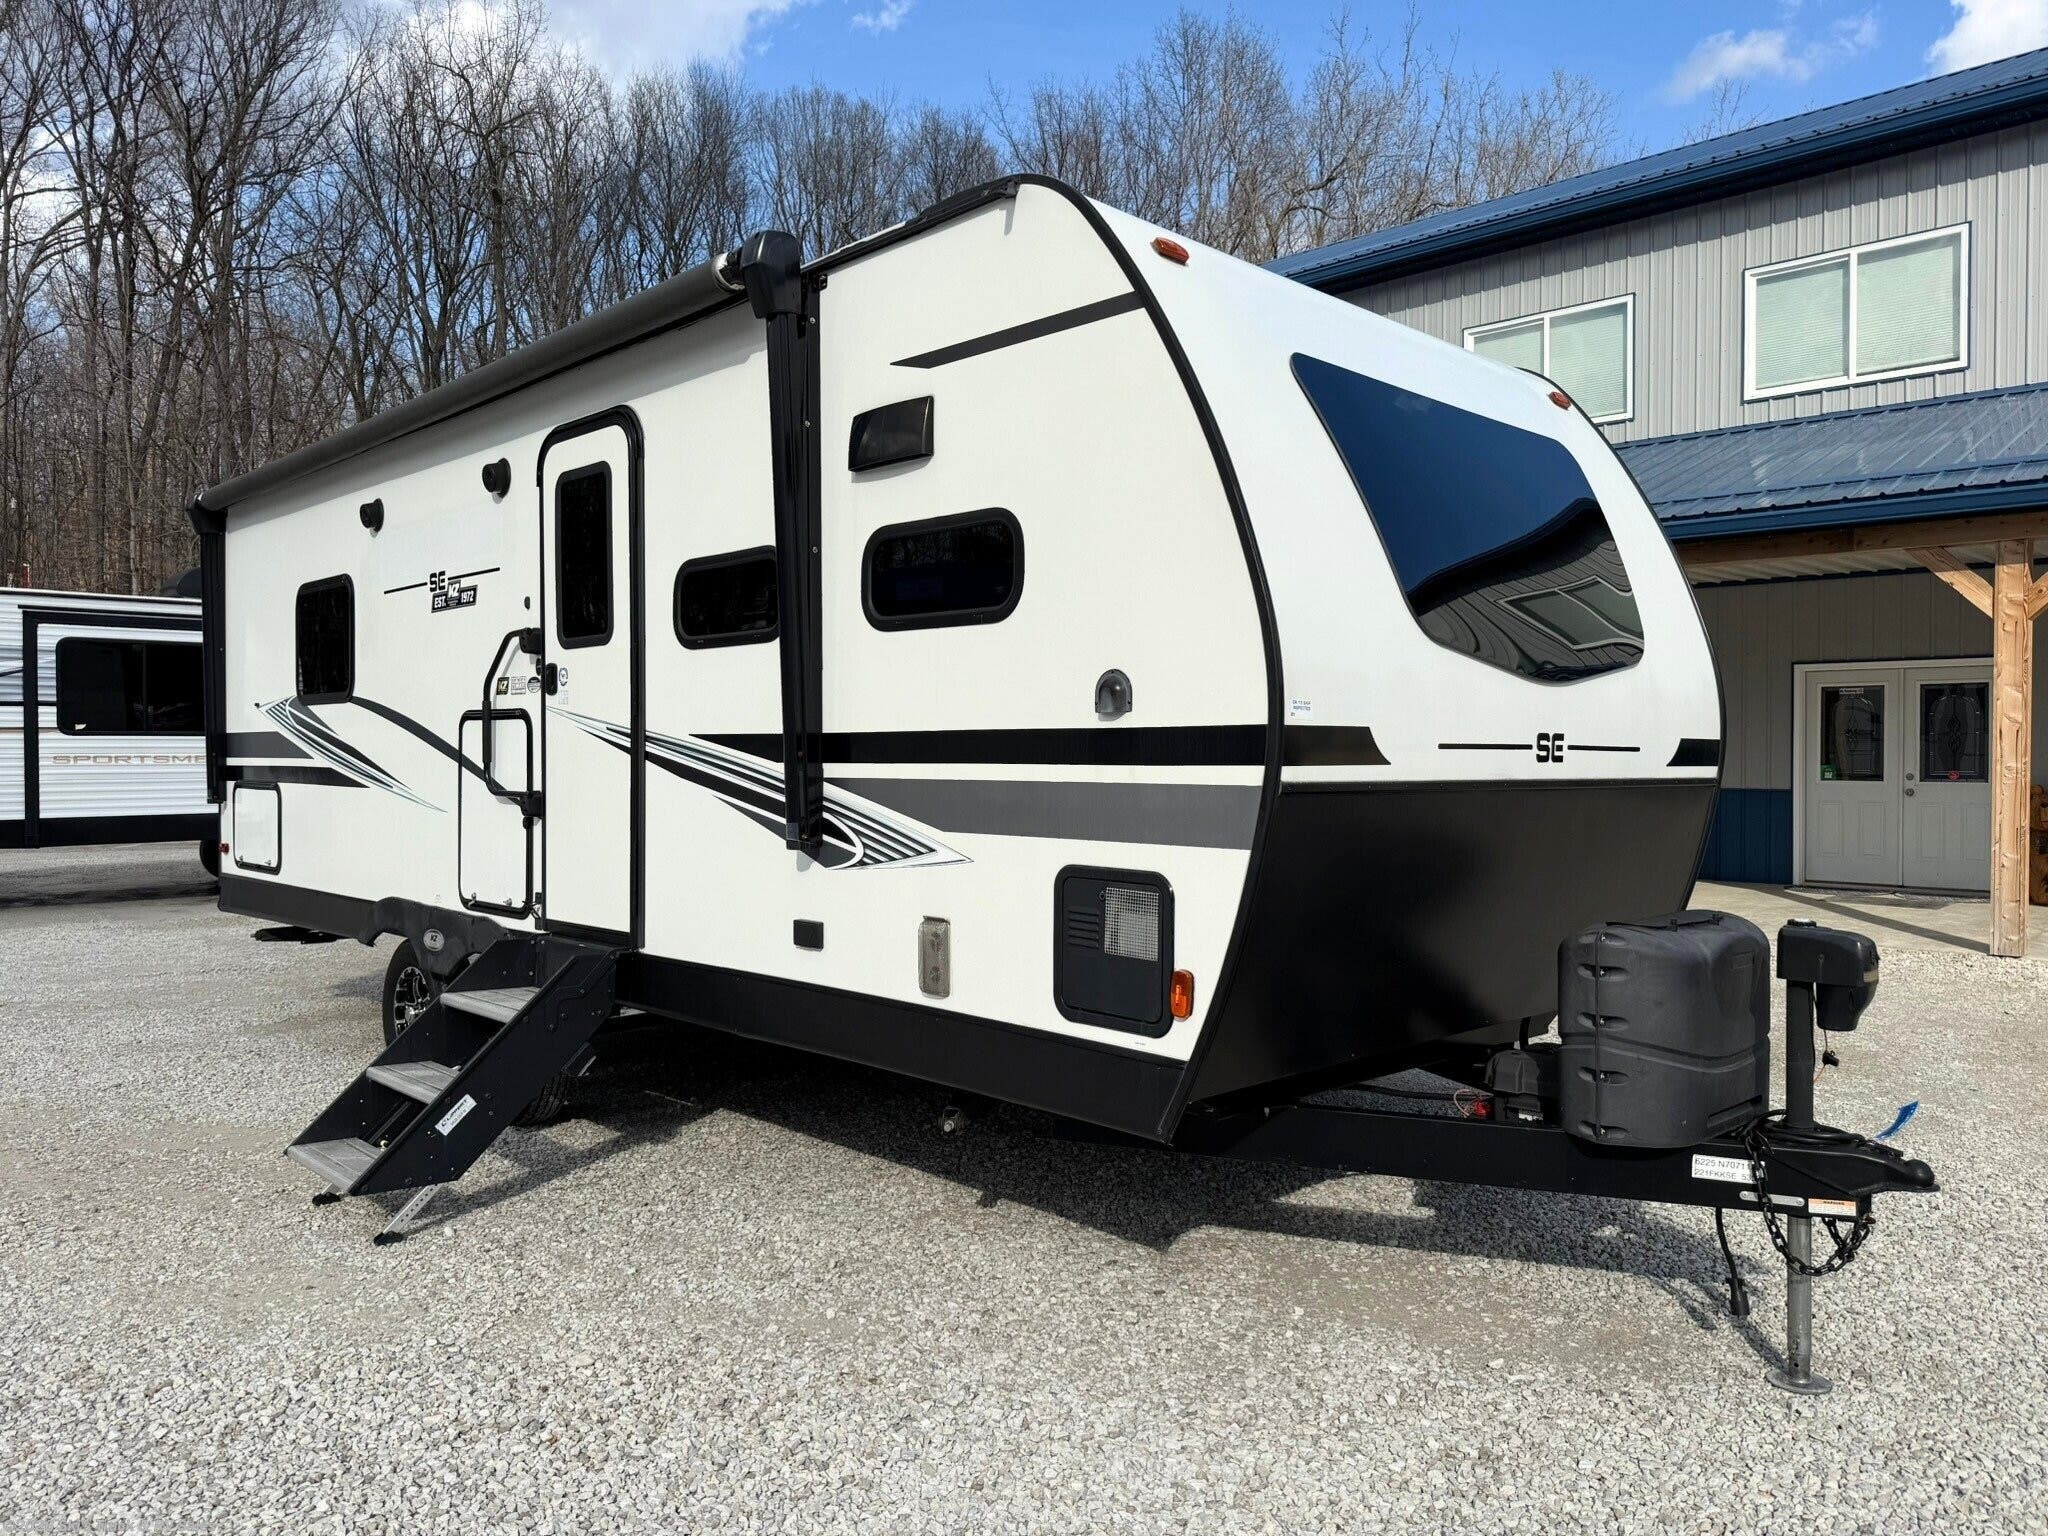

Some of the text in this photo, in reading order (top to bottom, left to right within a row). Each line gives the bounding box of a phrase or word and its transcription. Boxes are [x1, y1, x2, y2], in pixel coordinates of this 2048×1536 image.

[430, 570, 446, 593] SE
[447, 582, 460, 599] KZ
[434, 595, 447, 609] EST.
[460, 590, 475, 603] 1972
[1536, 732, 1565, 763] SE
